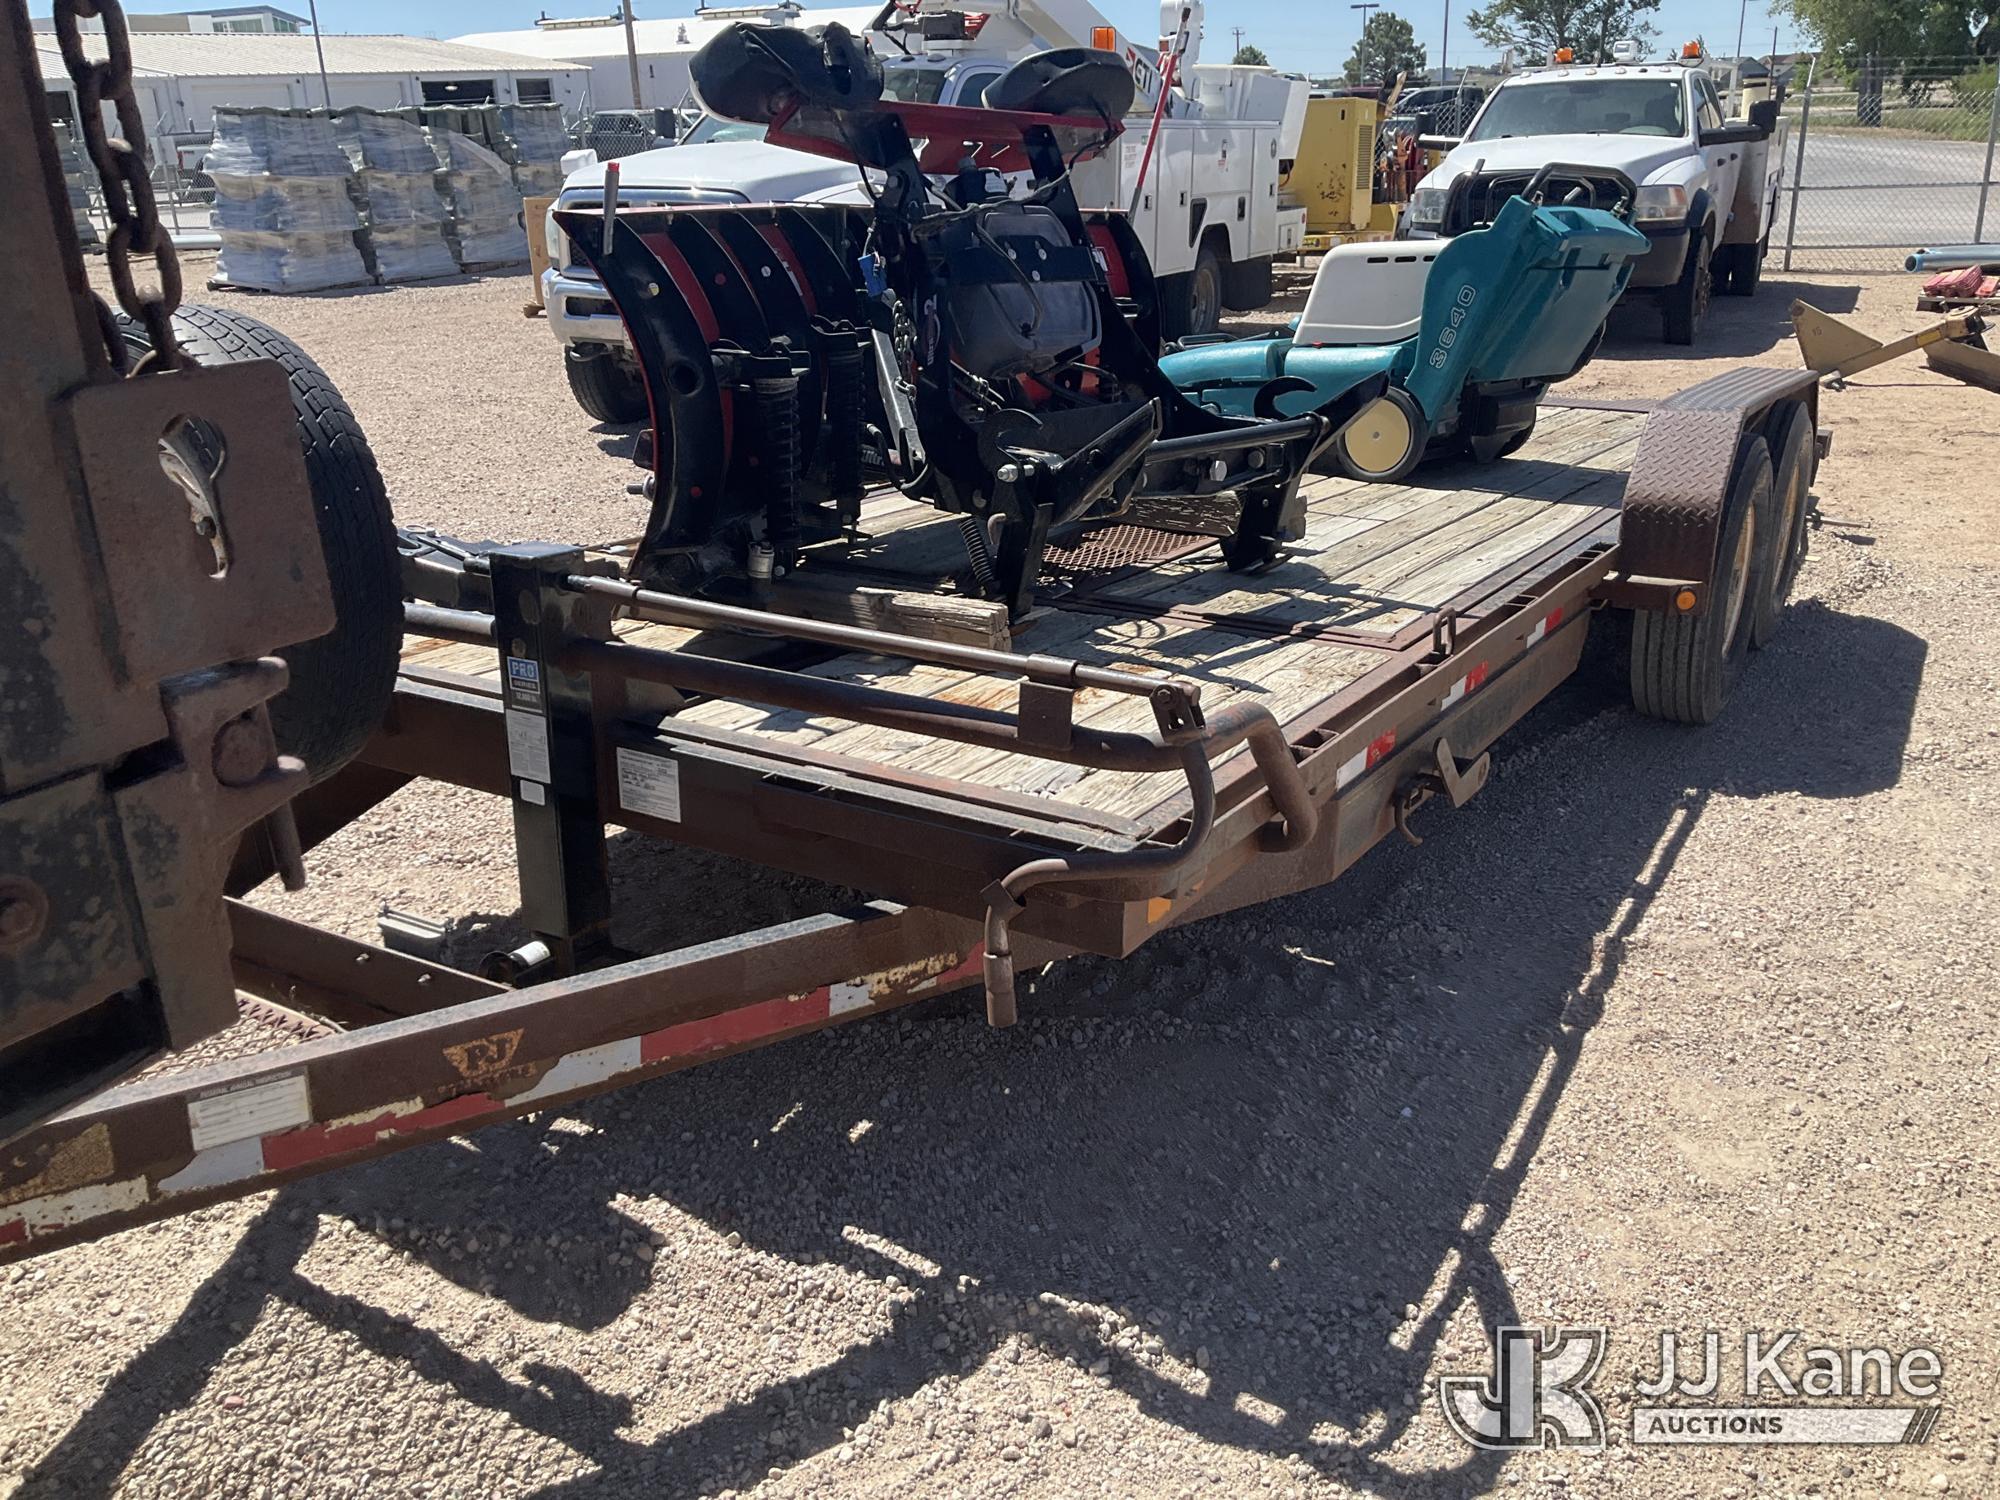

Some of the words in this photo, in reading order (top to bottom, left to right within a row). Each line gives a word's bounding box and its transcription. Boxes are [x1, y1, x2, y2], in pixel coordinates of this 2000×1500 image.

[1135, 58, 1153, 94] ETI
[1429, 284, 1477, 369] 3640
[511, 660, 535, 678] PRO
[467, 1037, 510, 1071] PJ
